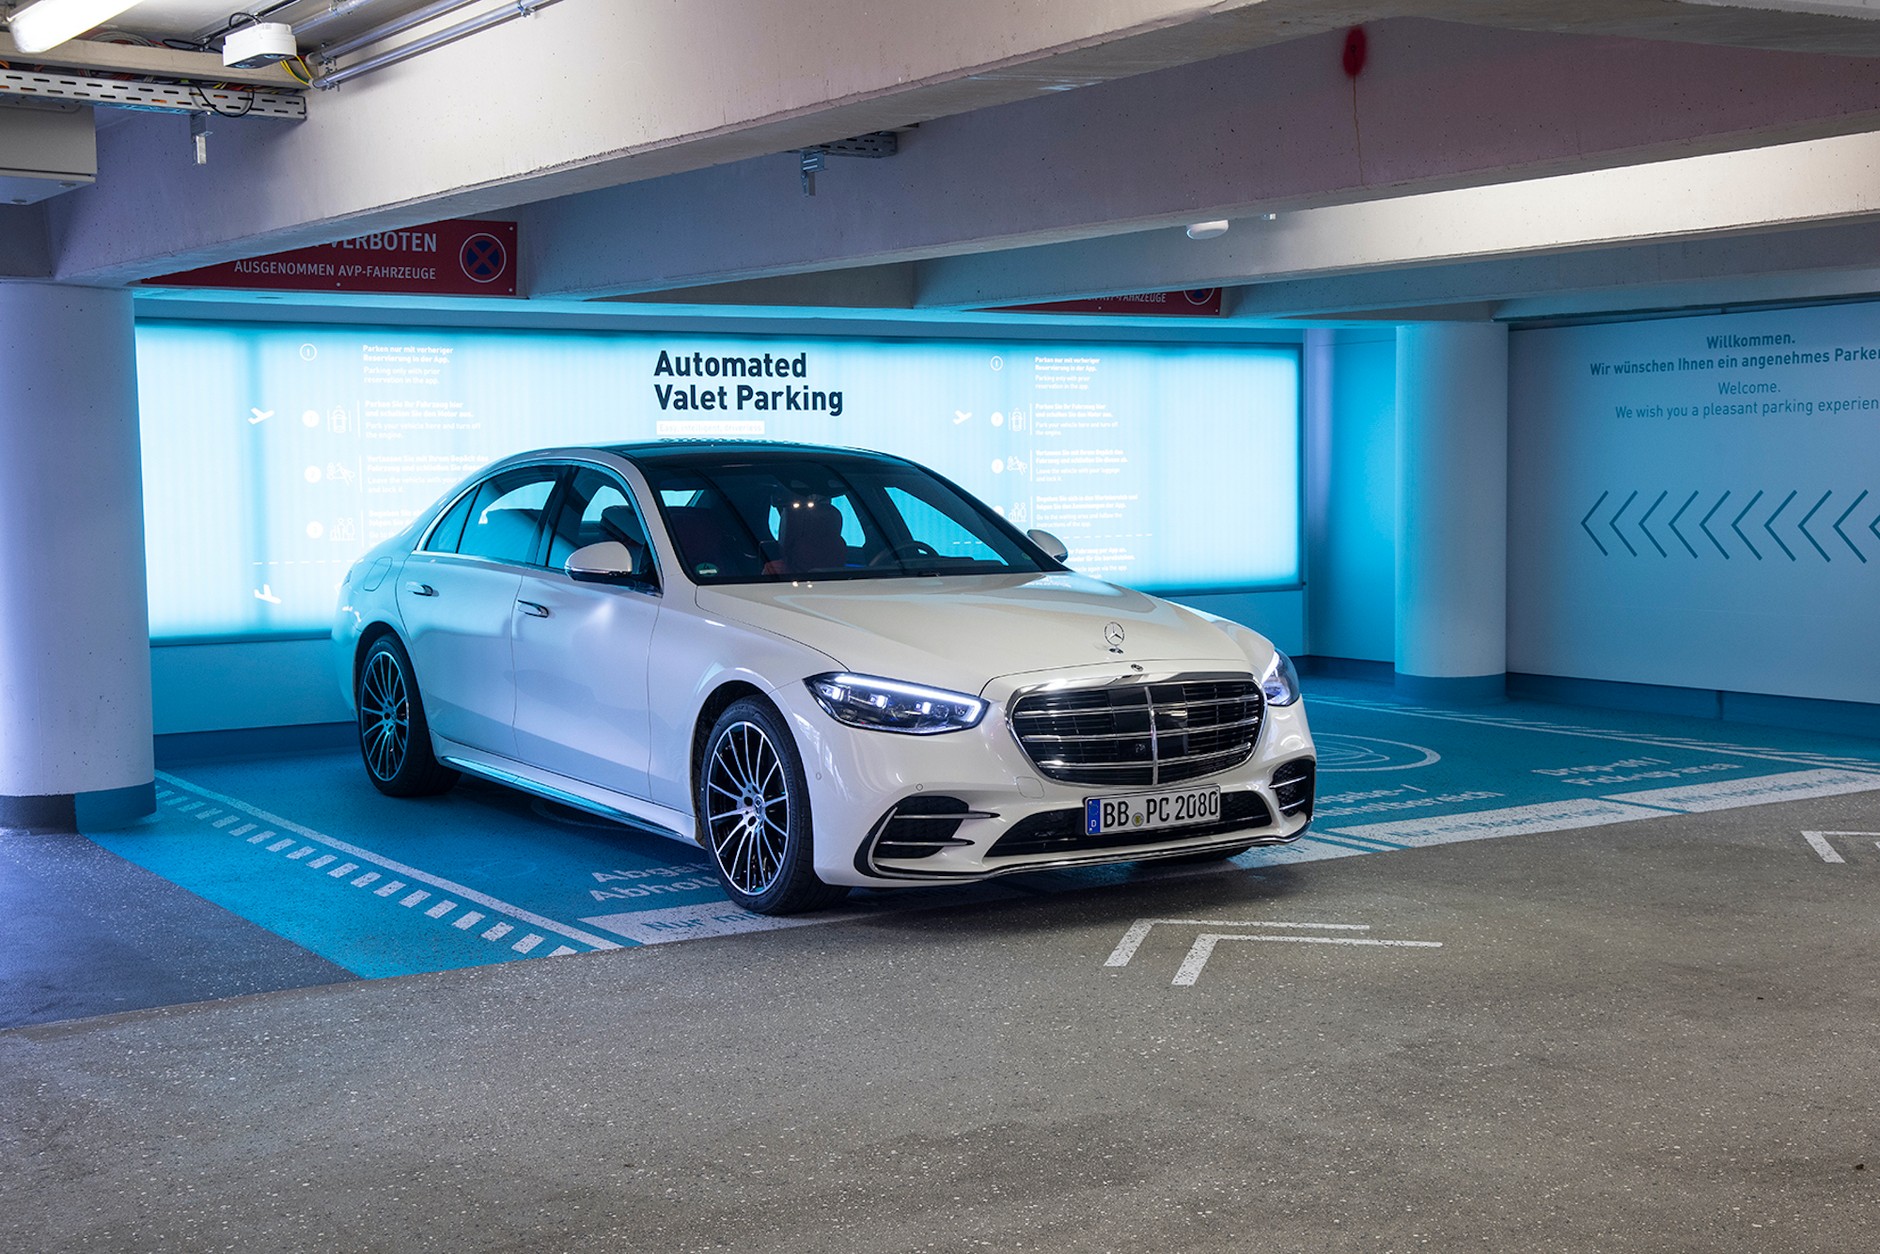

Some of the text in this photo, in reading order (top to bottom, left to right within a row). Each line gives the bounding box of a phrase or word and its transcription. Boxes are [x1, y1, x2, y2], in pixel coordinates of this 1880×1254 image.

[234, 261, 436, 280] AUSGENOMMEN AVP-FAHRZEUGE
[1706, 333, 1796, 349] Willkommen.
[654, 350, 806, 378] Automated
[1590, 363, 1610, 376] Wir
[1614, 360, 1674, 374] wünschen
[1678, 357, 1714, 371] Ihnen
[1718, 354, 1738, 368] ein
[1742, 350, 1830, 371] angenehmes
[1718, 382, 1781, 395] Welcome.
[654, 384, 843, 416] Valet Parking
[1616, 406, 1633, 418] We
[1636, 404, 1663, 418] wish
[1667, 407, 1688, 420] you
[1692, 406, 1699, 416] a
[1703, 402, 1758, 418] pleasant
[1762, 399, 1813, 417] parking
[1103, 791, 1218, 828] BB PC 2080
[1090, 820, 1097, 828] D
[640, 917, 704, 932] Nur
